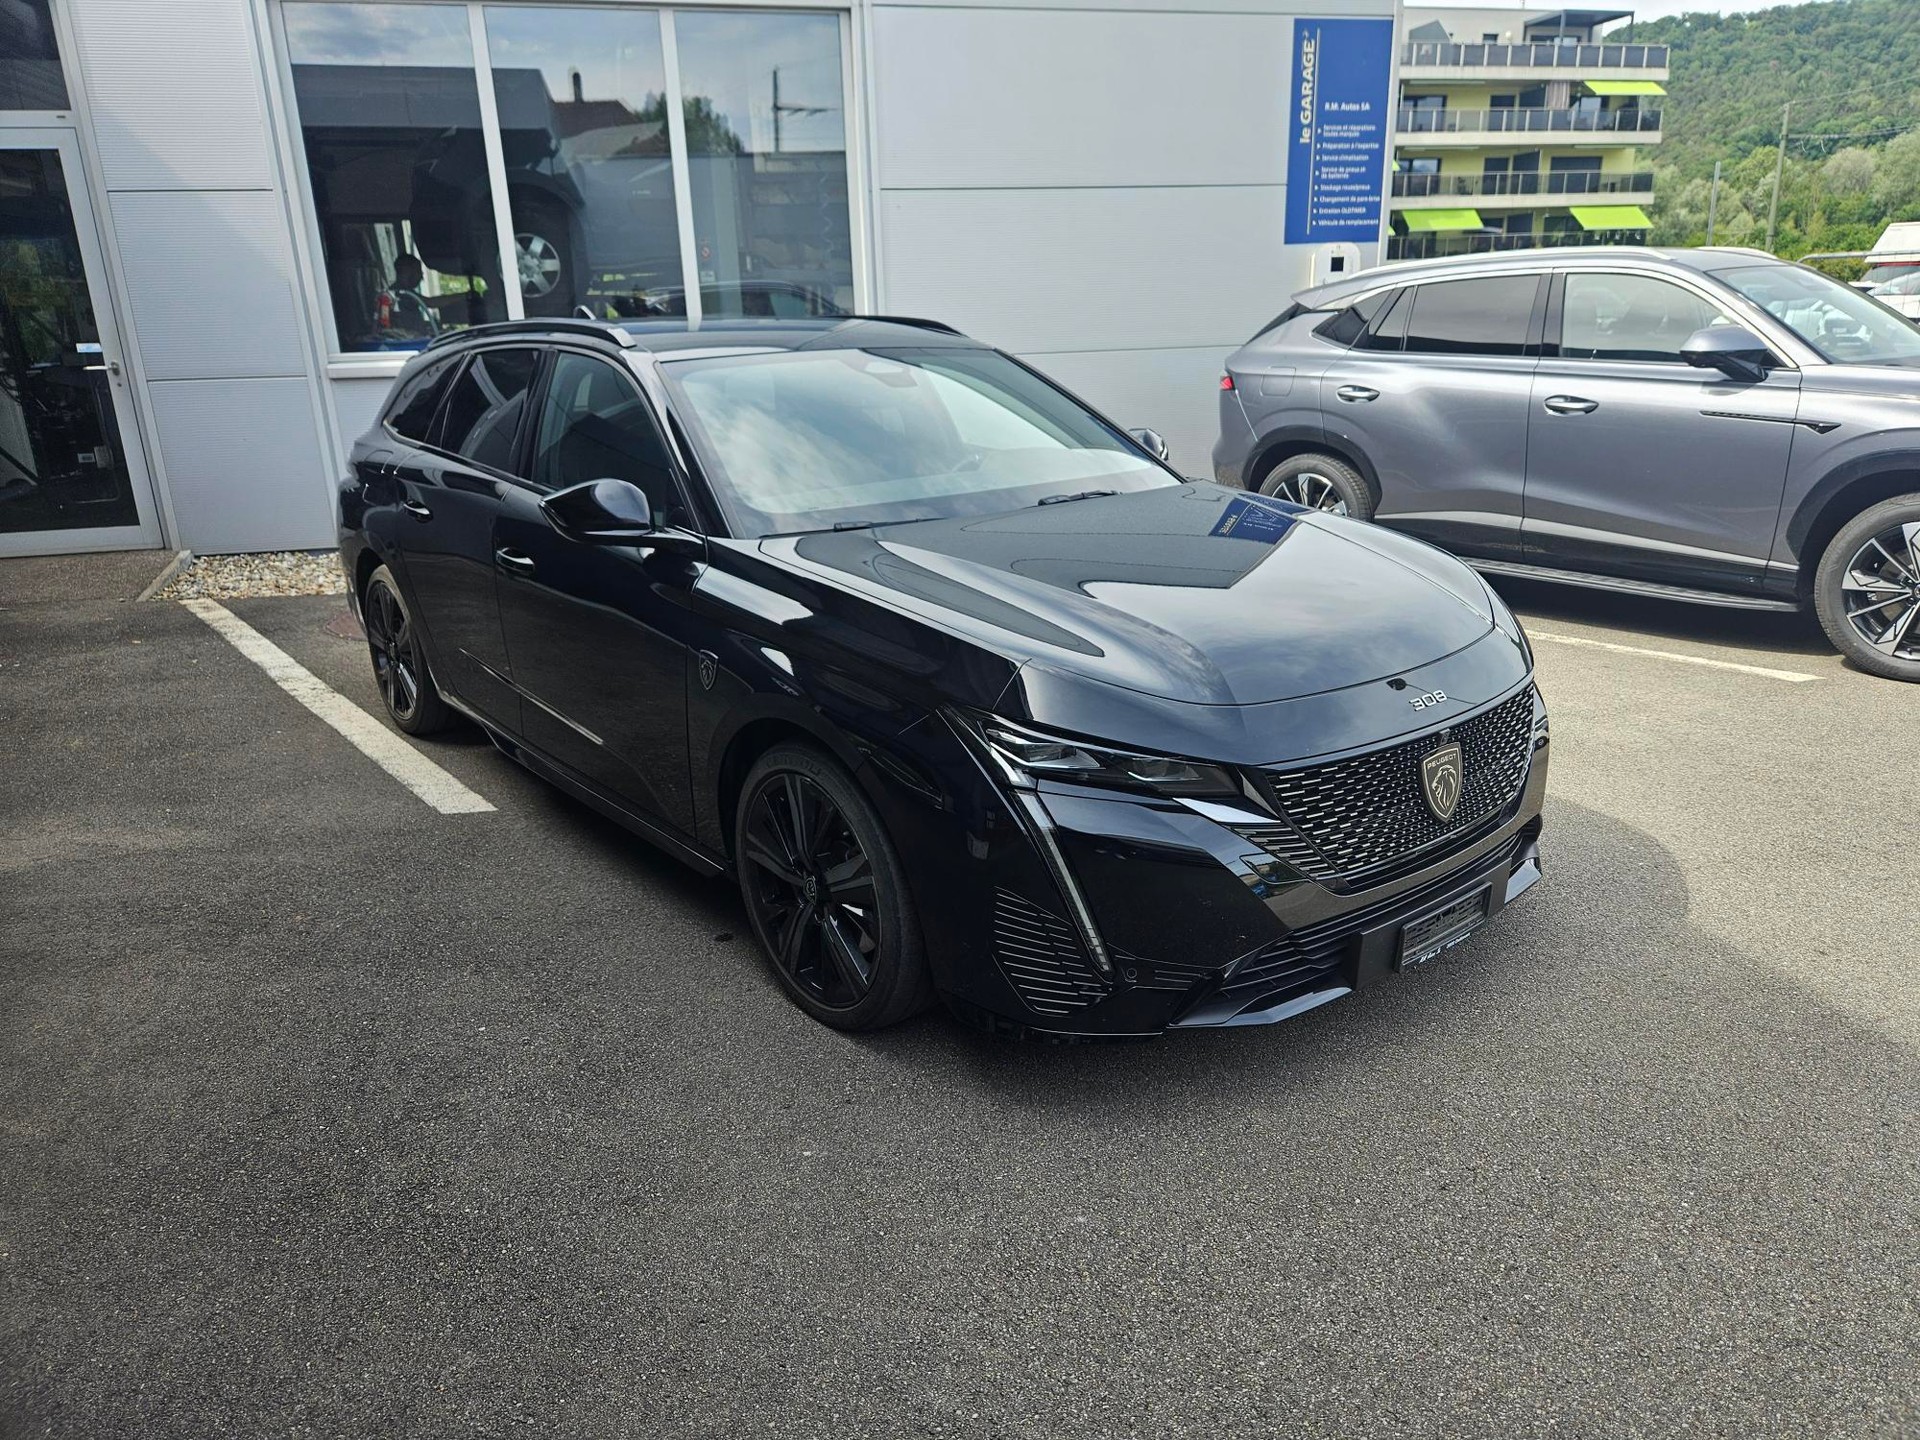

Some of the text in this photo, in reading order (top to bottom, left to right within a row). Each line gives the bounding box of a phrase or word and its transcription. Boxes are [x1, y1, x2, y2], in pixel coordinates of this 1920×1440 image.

[1300, 39, 1315, 144] le GARAGE
[1340, 102, 1360, 111] Autos
[1361, 102, 1371, 111] SA
[1409, 690, 1448, 711] 308
[1426, 753, 1457, 770] PEUGEOT
